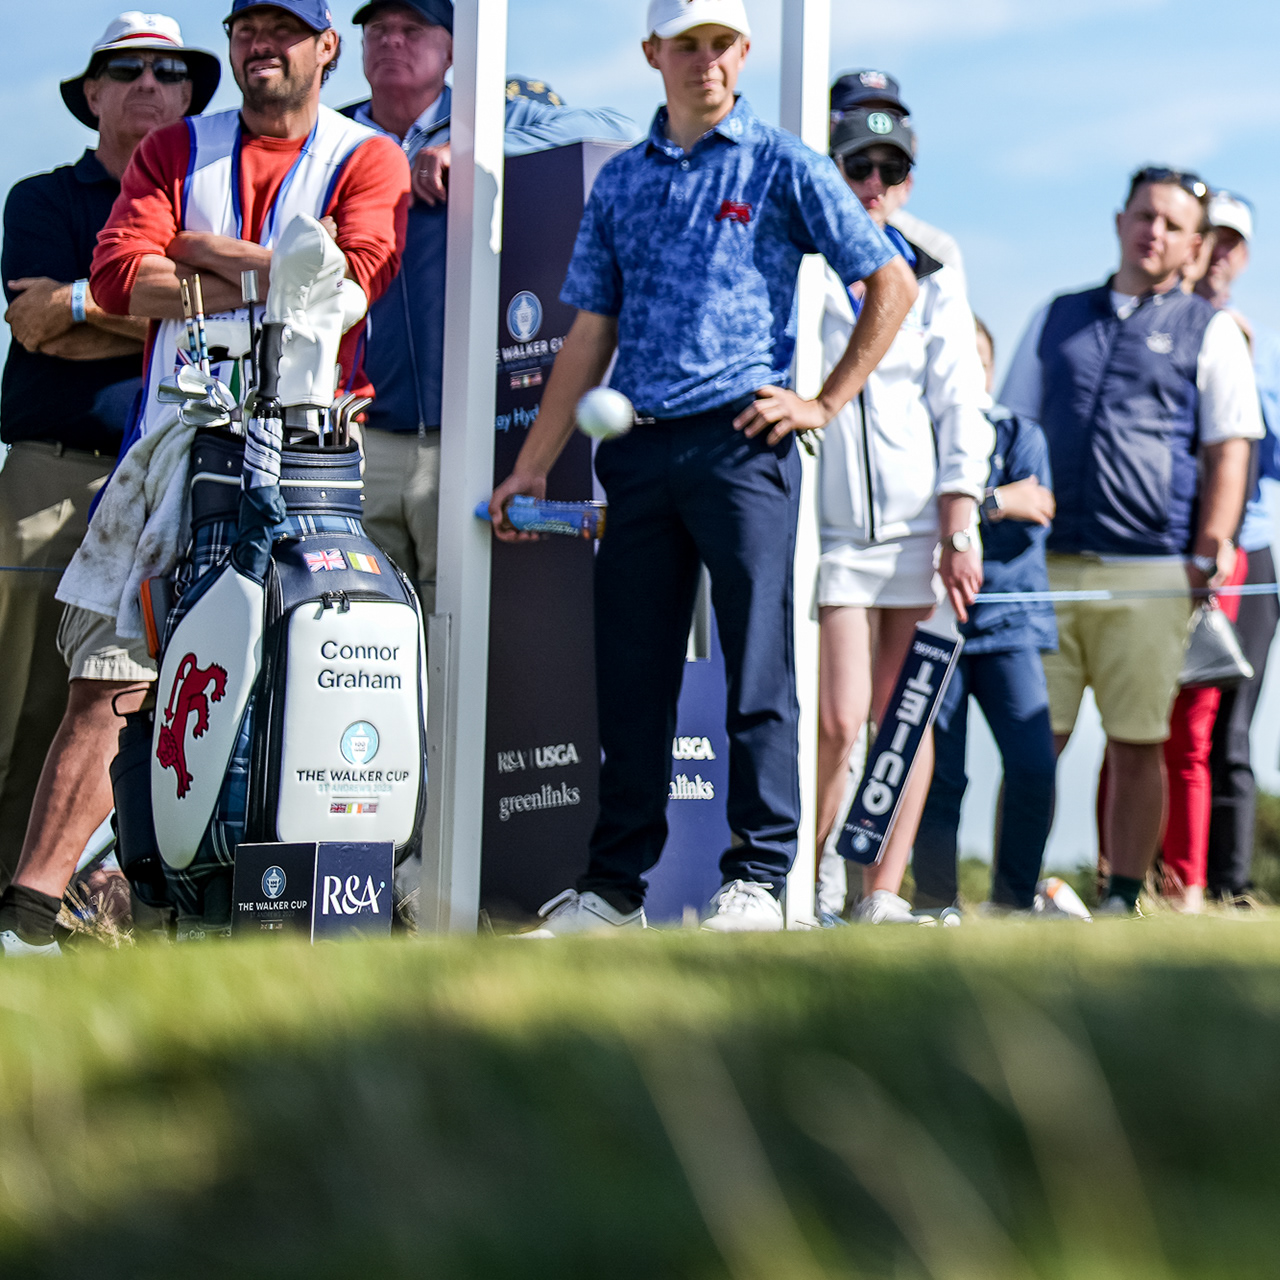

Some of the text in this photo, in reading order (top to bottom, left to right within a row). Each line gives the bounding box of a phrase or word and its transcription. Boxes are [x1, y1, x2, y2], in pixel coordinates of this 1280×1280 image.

[501, 339, 549, 362] WALKER
[320, 640, 400, 661] Connor
[317, 668, 402, 690] Graham
[672, 736, 716, 760] USGA
[861, 660, 936, 816] QUIET
[497, 742, 580, 774] R&A USGA
[296, 769, 410, 782] THE WALKER CUP
[331, 783, 371, 793] ANDREWS
[499, 780, 581, 822] greenlinks
[238, 899, 308, 912] THE WALKER CUP
[321, 874, 386, 915] R&A
